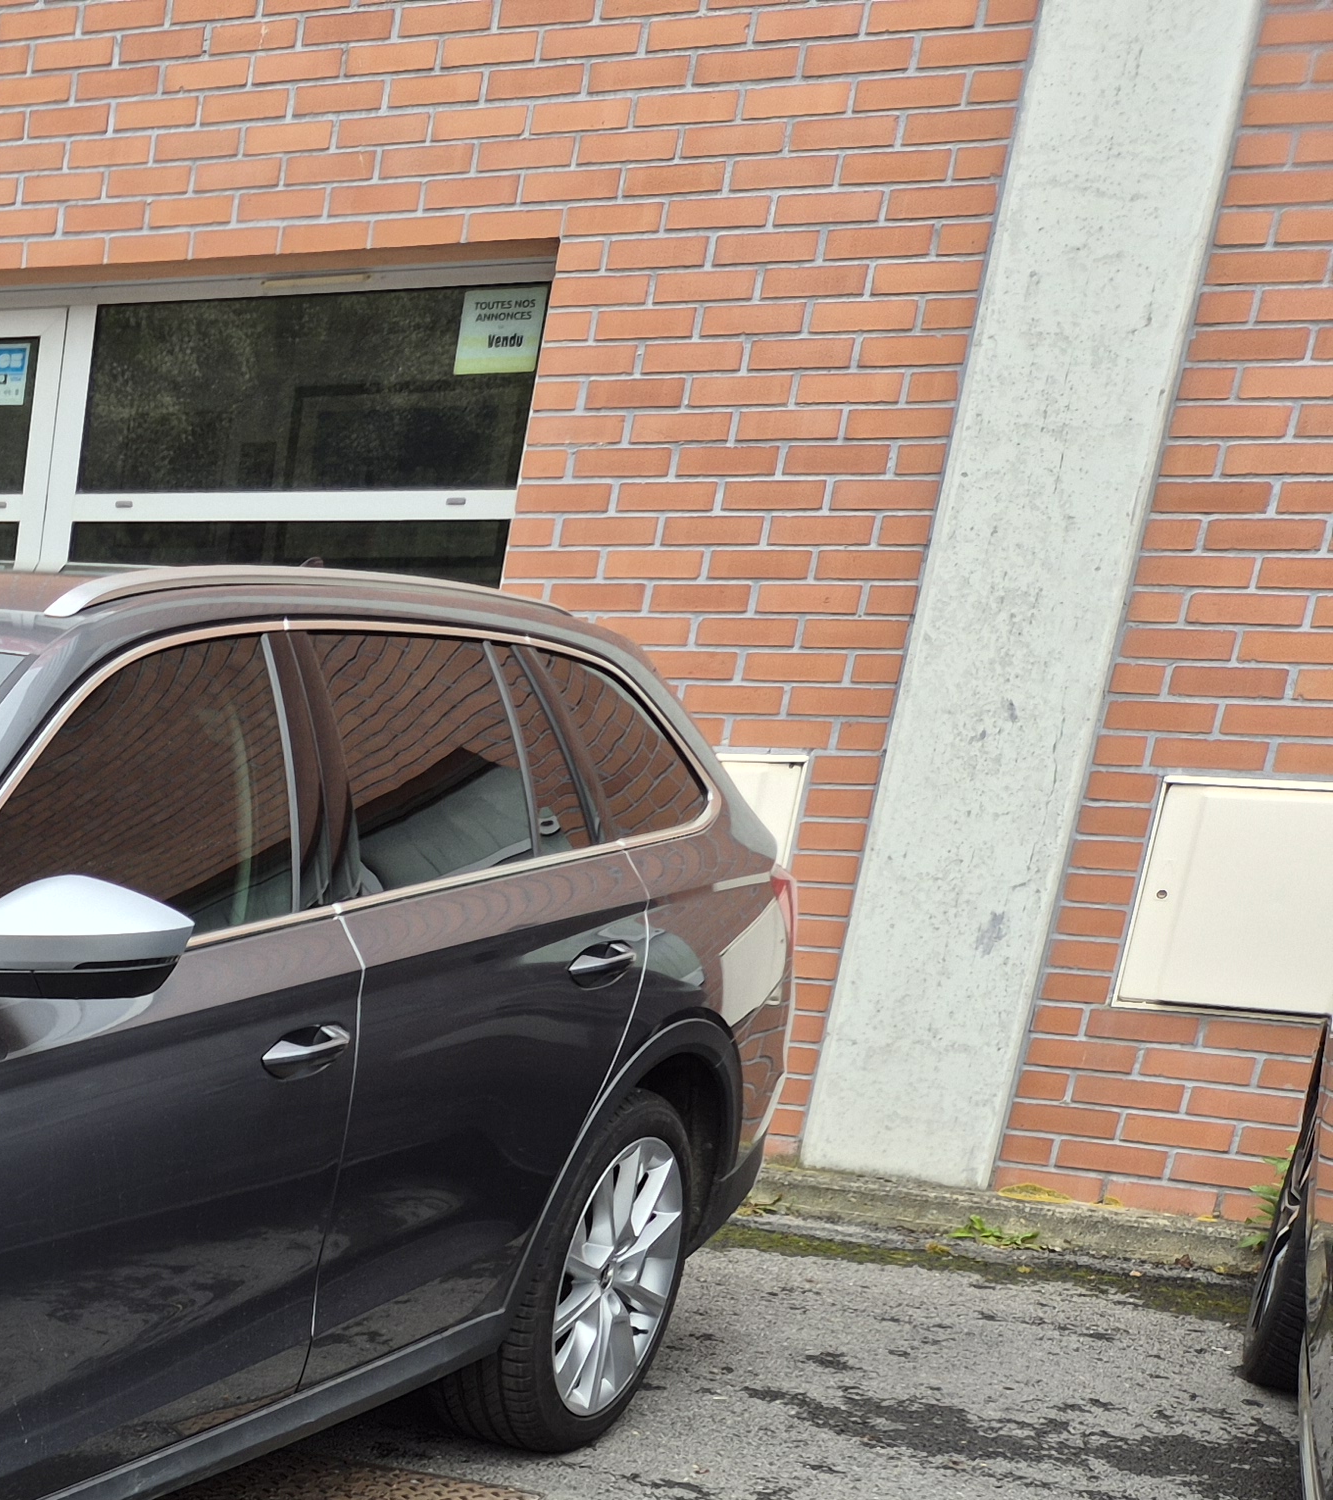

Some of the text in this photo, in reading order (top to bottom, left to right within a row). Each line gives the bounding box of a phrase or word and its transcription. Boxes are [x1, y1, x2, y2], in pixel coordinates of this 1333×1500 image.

[474, 298, 536, 311] TOUTES NOS
[475, 310, 532, 323] ANNONCES
[487, 333, 524, 349] Vendu
